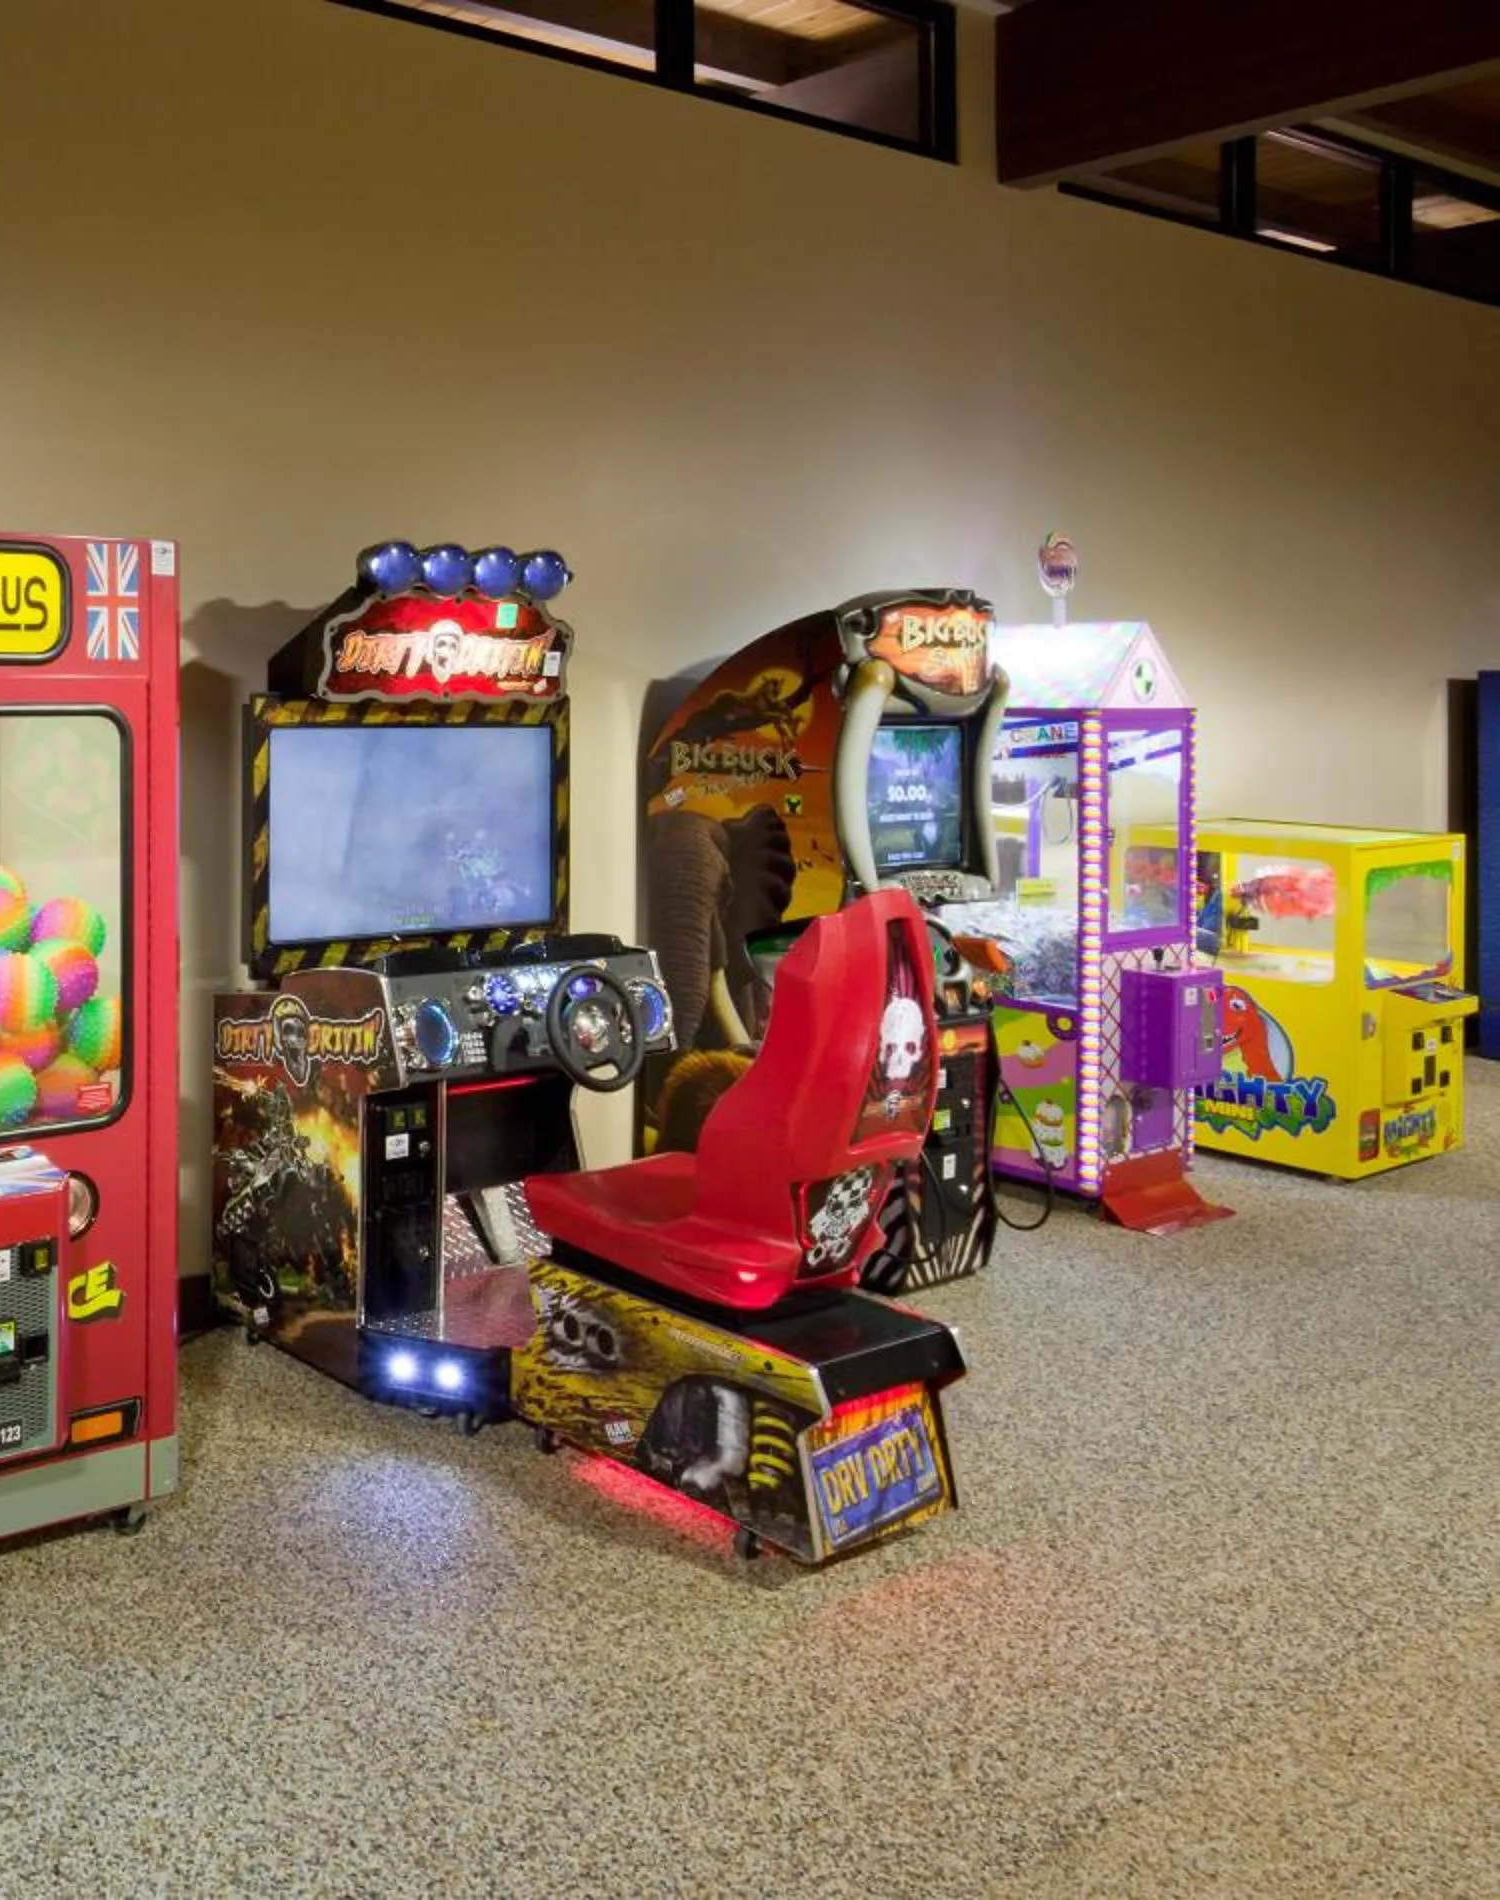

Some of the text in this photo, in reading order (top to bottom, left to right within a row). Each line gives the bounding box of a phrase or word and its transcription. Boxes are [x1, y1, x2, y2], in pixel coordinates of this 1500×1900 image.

[902, 614, 950, 652] BIG
[671, 740, 797, 782] BIG BUCK
[218, 1019, 275, 1063] DIRTY
[819, 1428, 925, 1515] DRV DRTY
